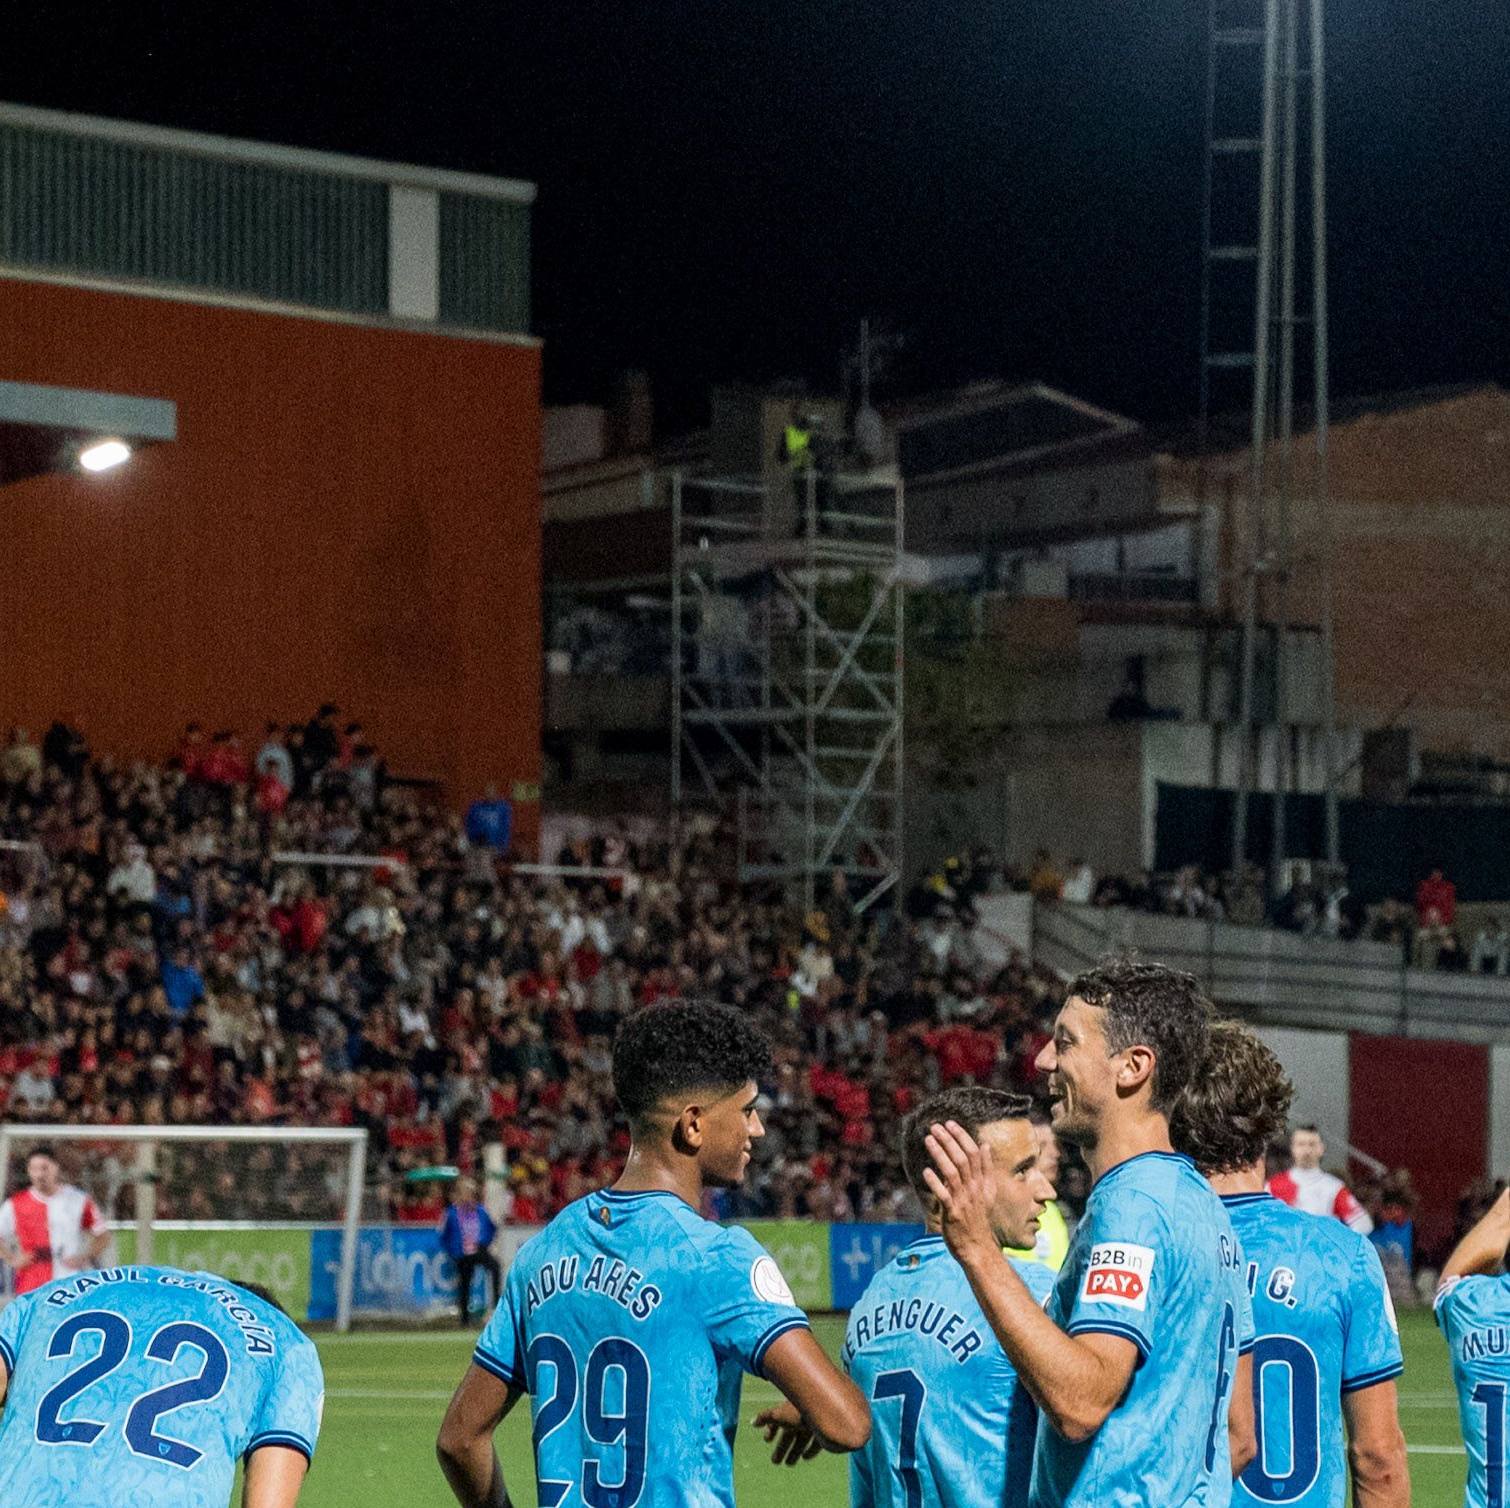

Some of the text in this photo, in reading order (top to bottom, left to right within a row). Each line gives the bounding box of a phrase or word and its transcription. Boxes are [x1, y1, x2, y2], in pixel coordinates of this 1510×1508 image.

[526, 1255, 662, 1321] ADU ARES
[36, 1310, 231, 1471] 22
